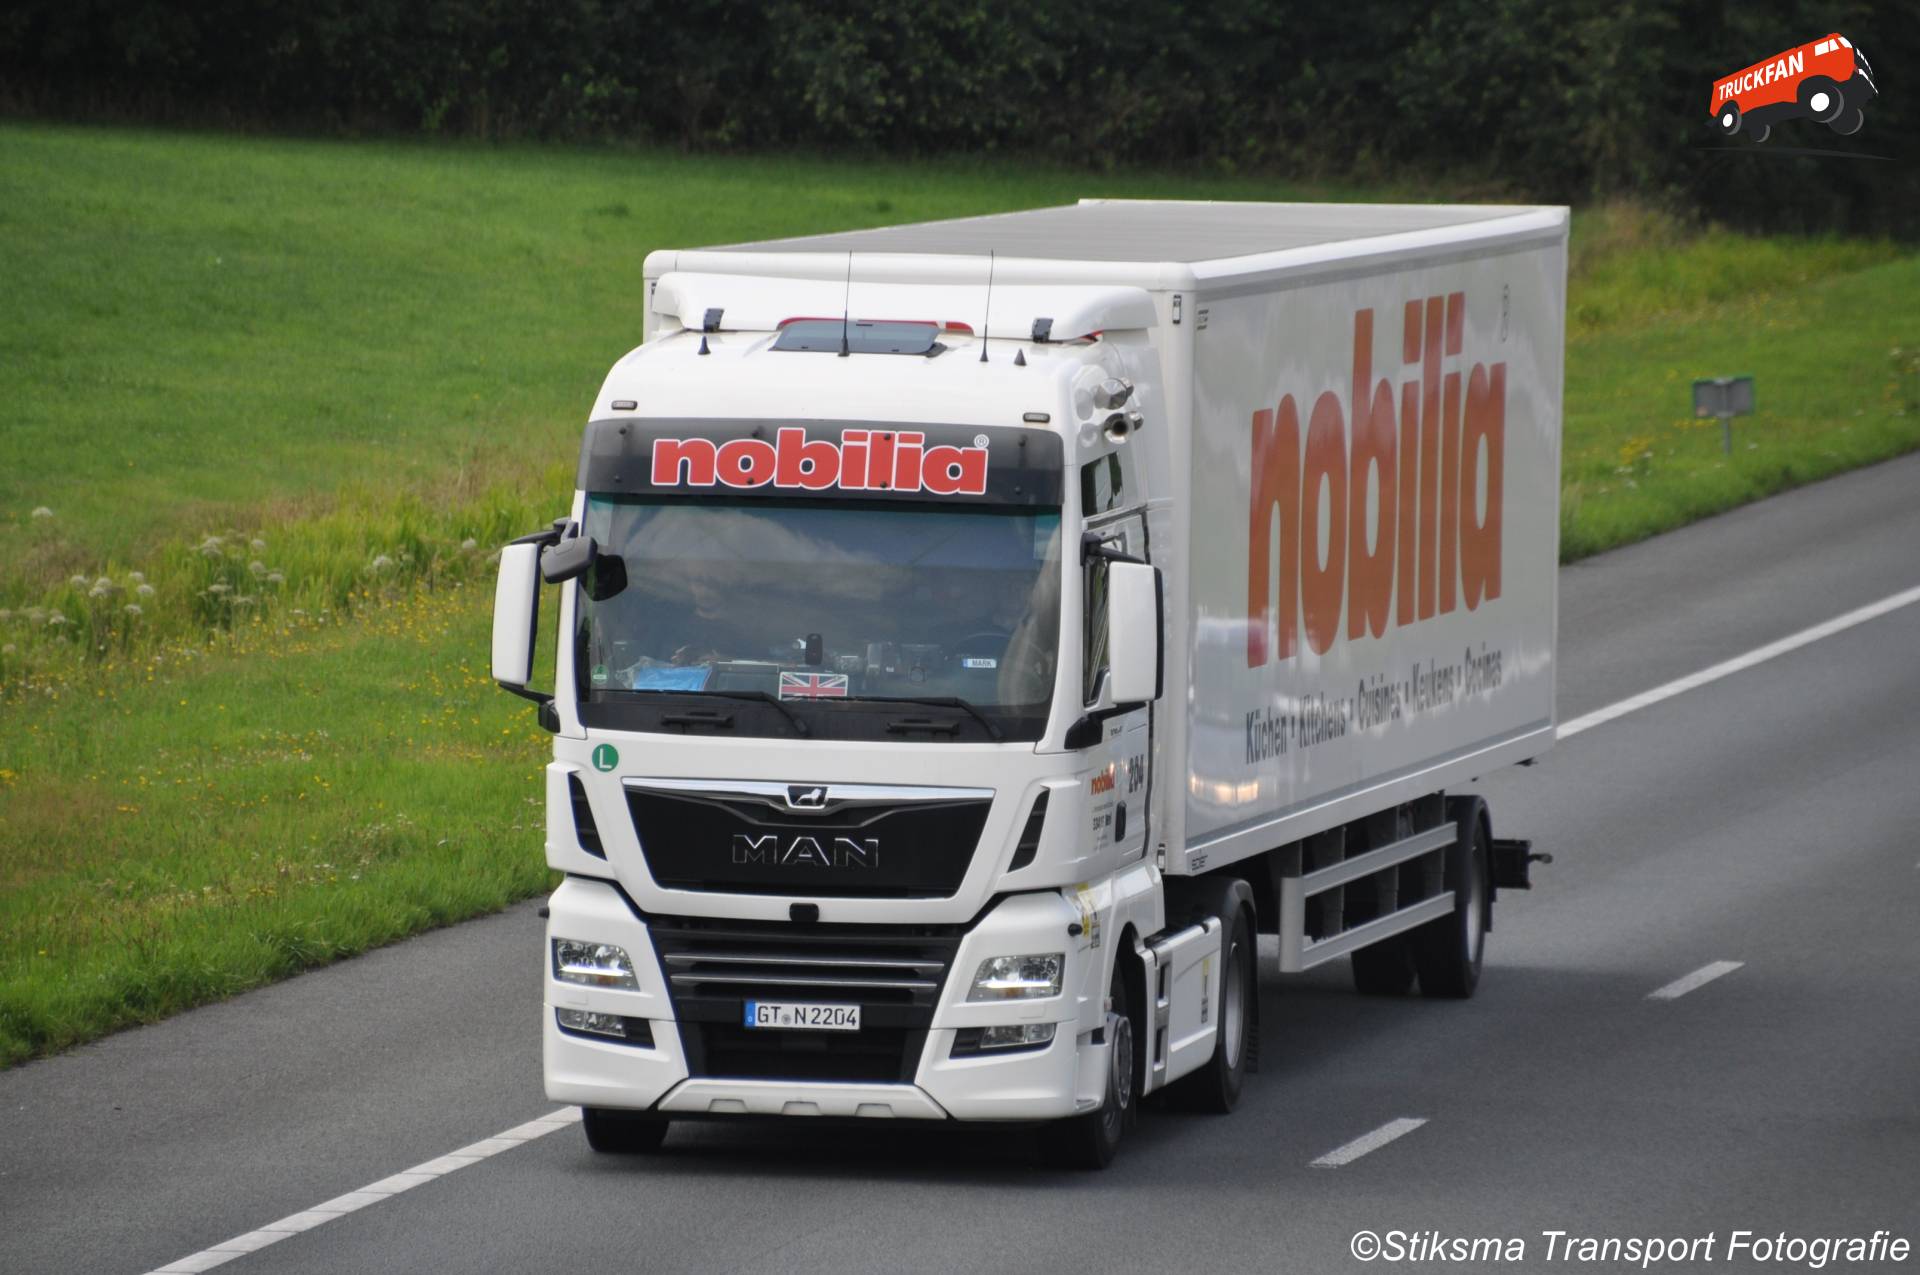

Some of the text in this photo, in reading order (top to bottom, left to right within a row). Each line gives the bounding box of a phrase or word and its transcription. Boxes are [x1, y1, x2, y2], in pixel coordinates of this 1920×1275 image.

[1247, 291, 1507, 669] nobilia
[1246, 706, 1287, 765] Küchen
[1299, 691, 1346, 749] Kitchens
[1358, 674, 1401, 730] Cuisines
[599, 748, 612, 769] L
[732, 834, 879, 868] MAN
[757, 1006, 782, 1024] GT
